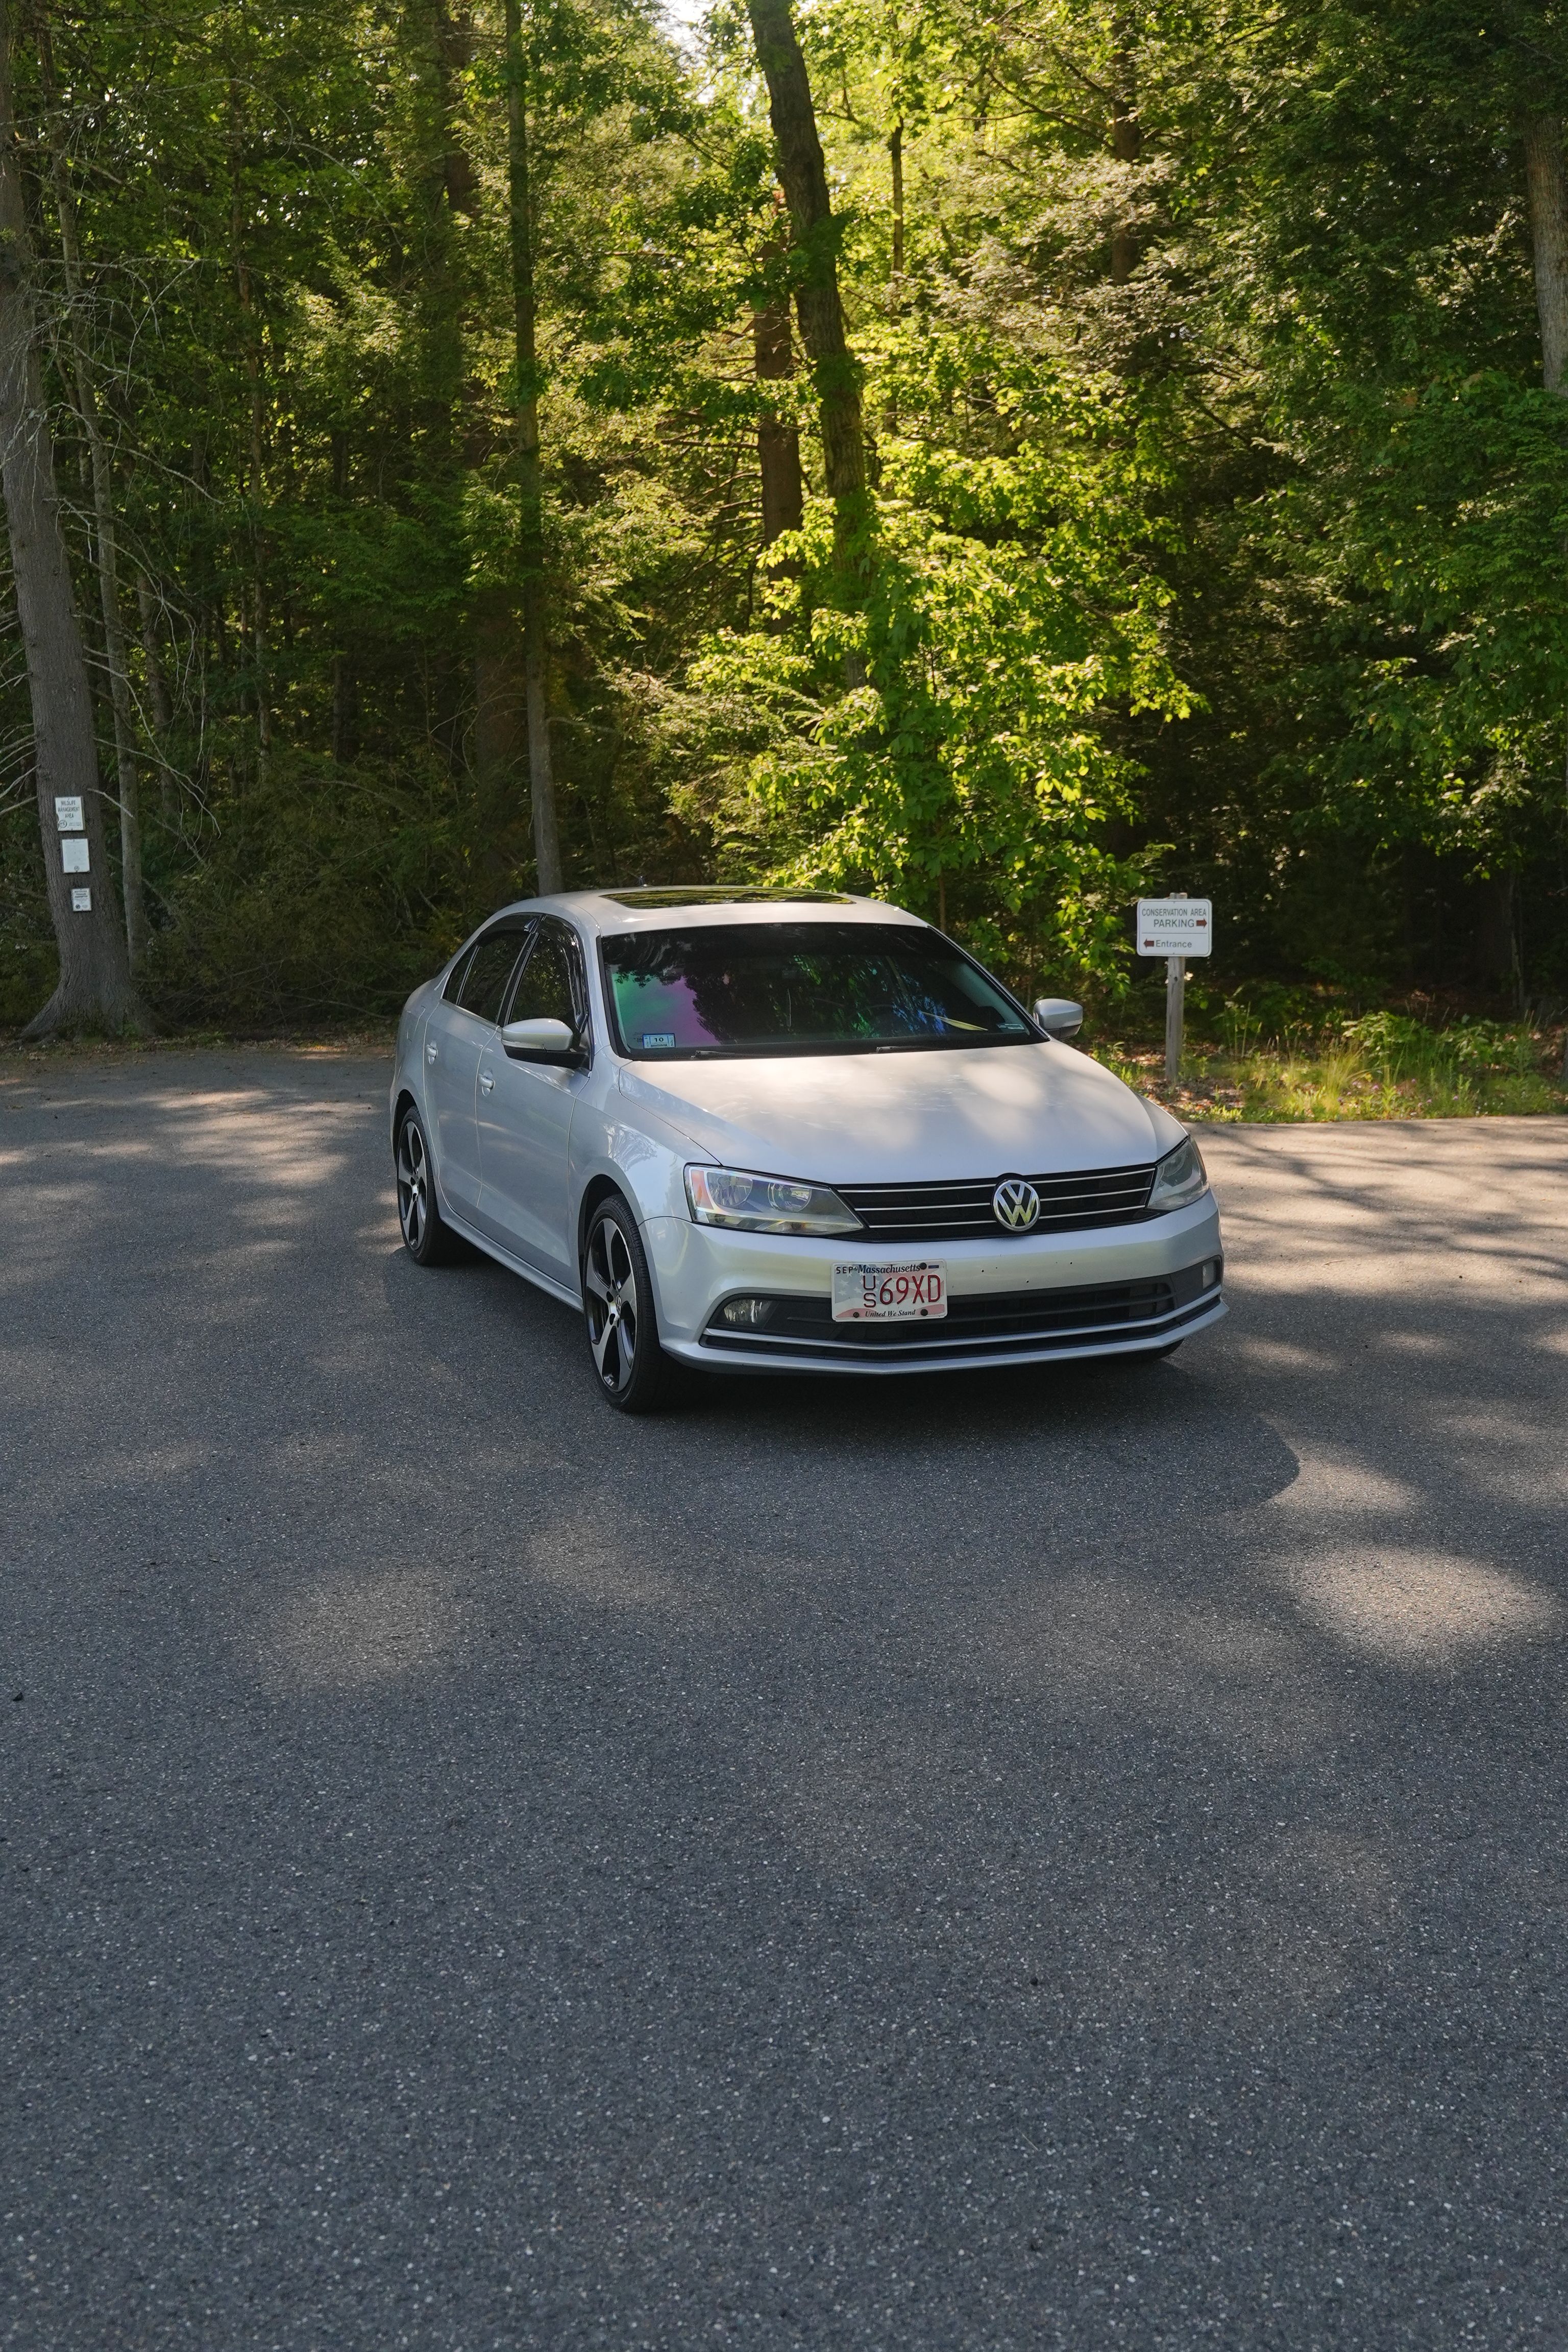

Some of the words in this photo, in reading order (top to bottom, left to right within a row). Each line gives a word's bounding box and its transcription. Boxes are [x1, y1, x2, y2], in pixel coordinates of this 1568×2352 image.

[1154, 919, 1194, 927] PARKING
[1156, 940, 1192, 948] Entrance
[836, 1266, 853, 1274] SEP
[857, 1264, 921, 1274] Massachusetts
